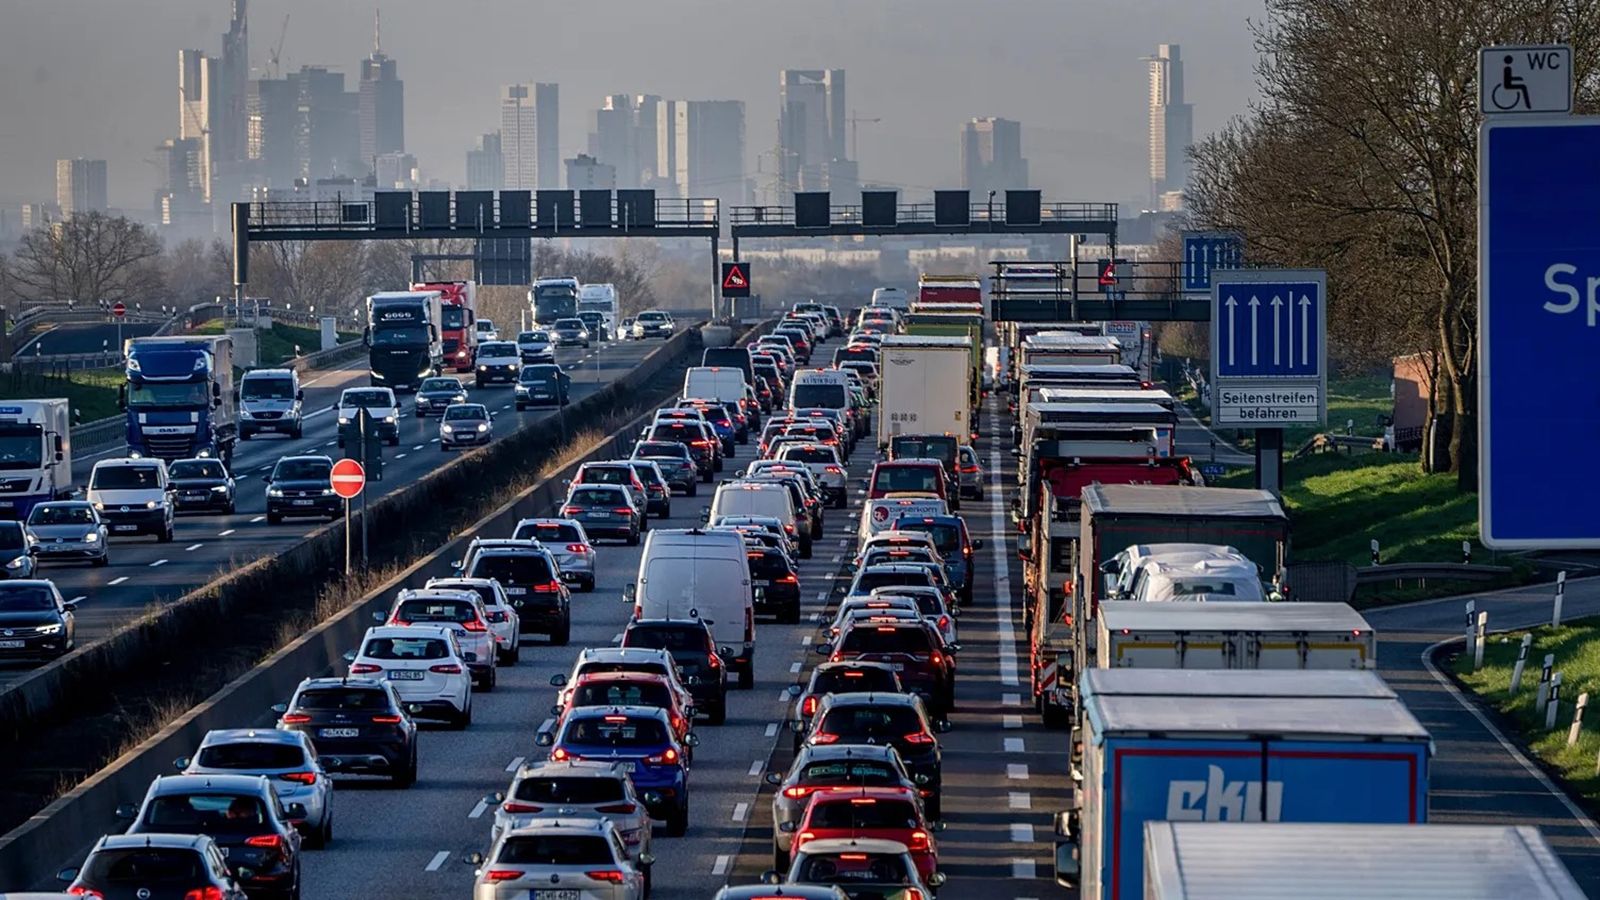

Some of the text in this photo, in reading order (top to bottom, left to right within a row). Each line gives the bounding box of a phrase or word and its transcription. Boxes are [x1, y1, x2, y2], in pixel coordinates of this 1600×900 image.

[1527, 52, 1560, 70] WC
[1223, 391, 1315, 405] Seitenstreifen
[1240, 407, 1297, 420] befahren
